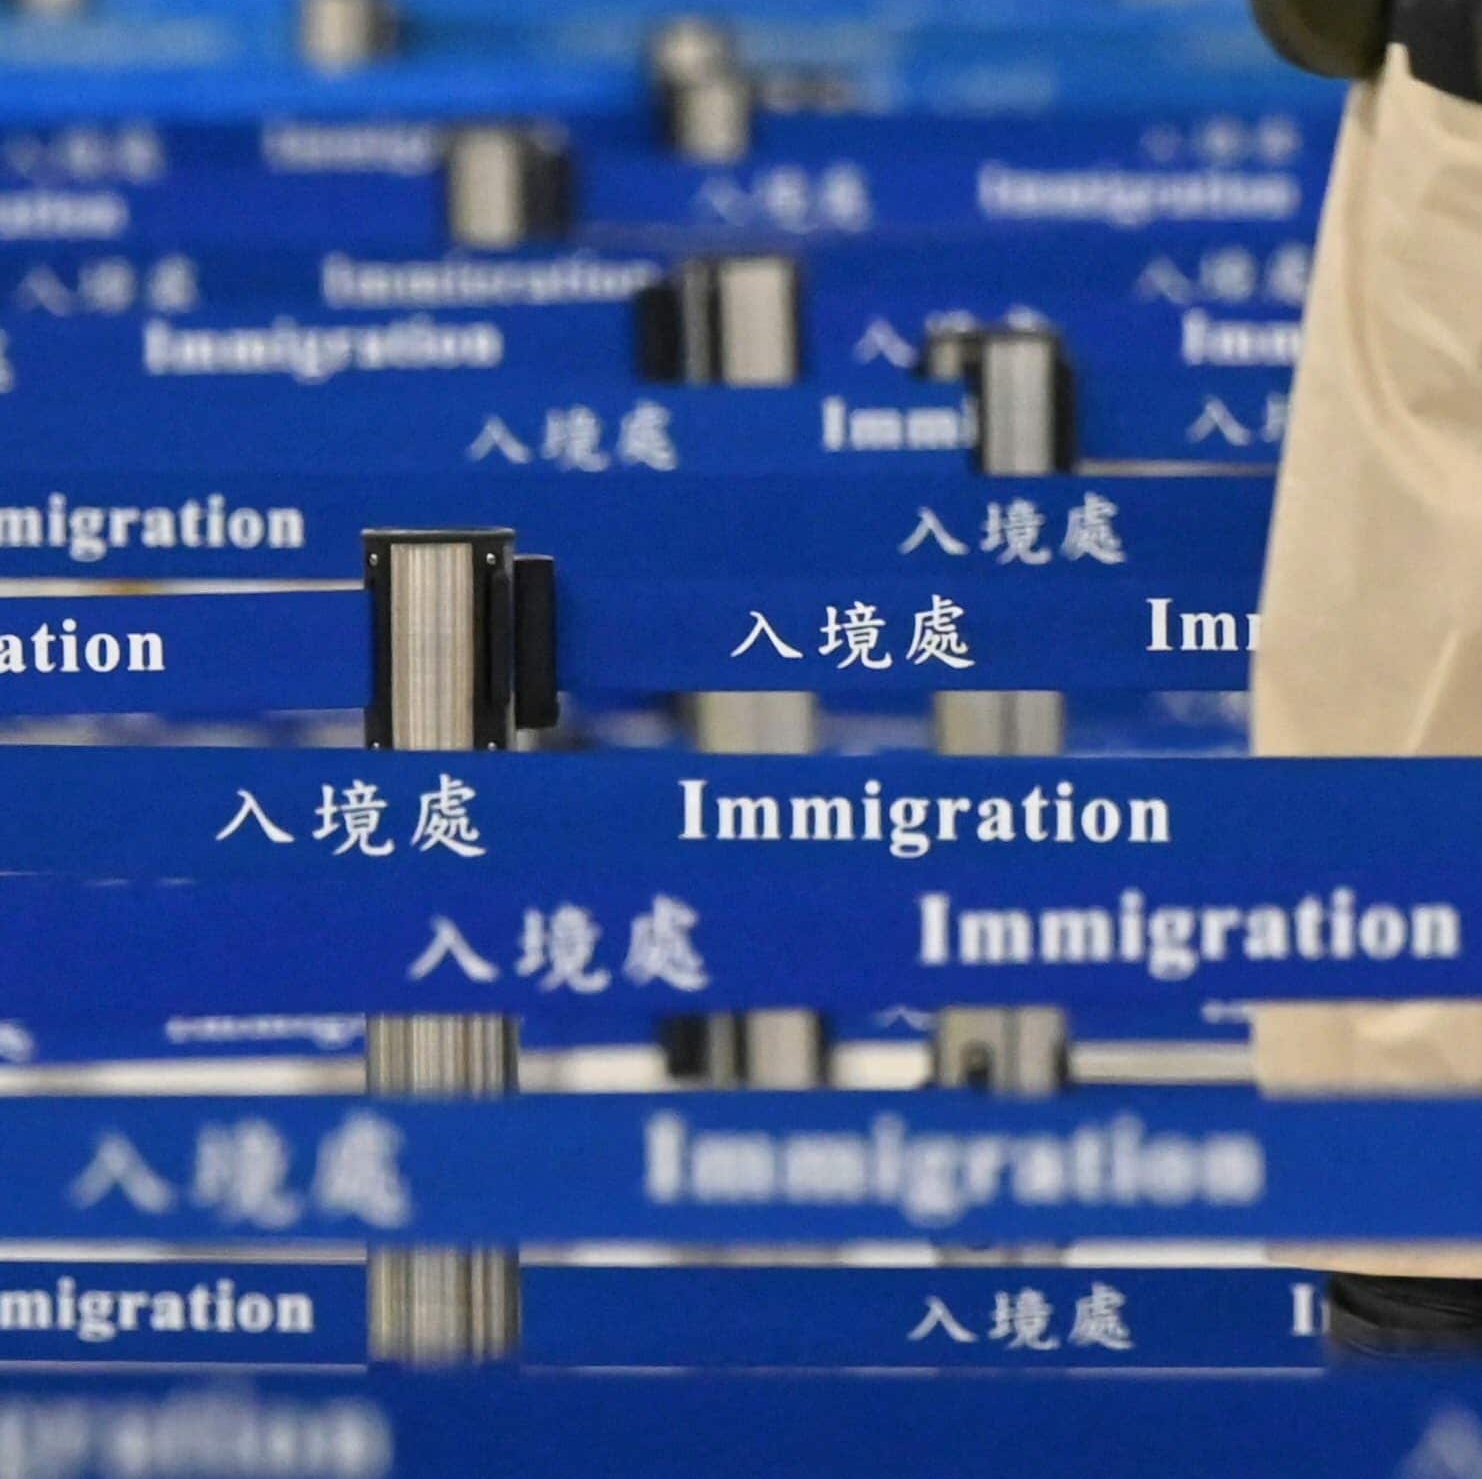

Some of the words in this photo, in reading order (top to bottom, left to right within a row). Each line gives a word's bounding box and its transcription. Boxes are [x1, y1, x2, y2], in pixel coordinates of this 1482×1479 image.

[902, 492, 1125, 565] 入境處
[731, 594, 975, 670] 入境處
[216, 773, 486, 858] 入境處
[679, 779, 1170, 859] Immigration
[410, 895, 708, 993] 入境處
[920, 888, 1460, 979] Immigration
[645, 1113, 1265, 1223] Immigration
[909, 1282, 1132, 1351] 入境處
